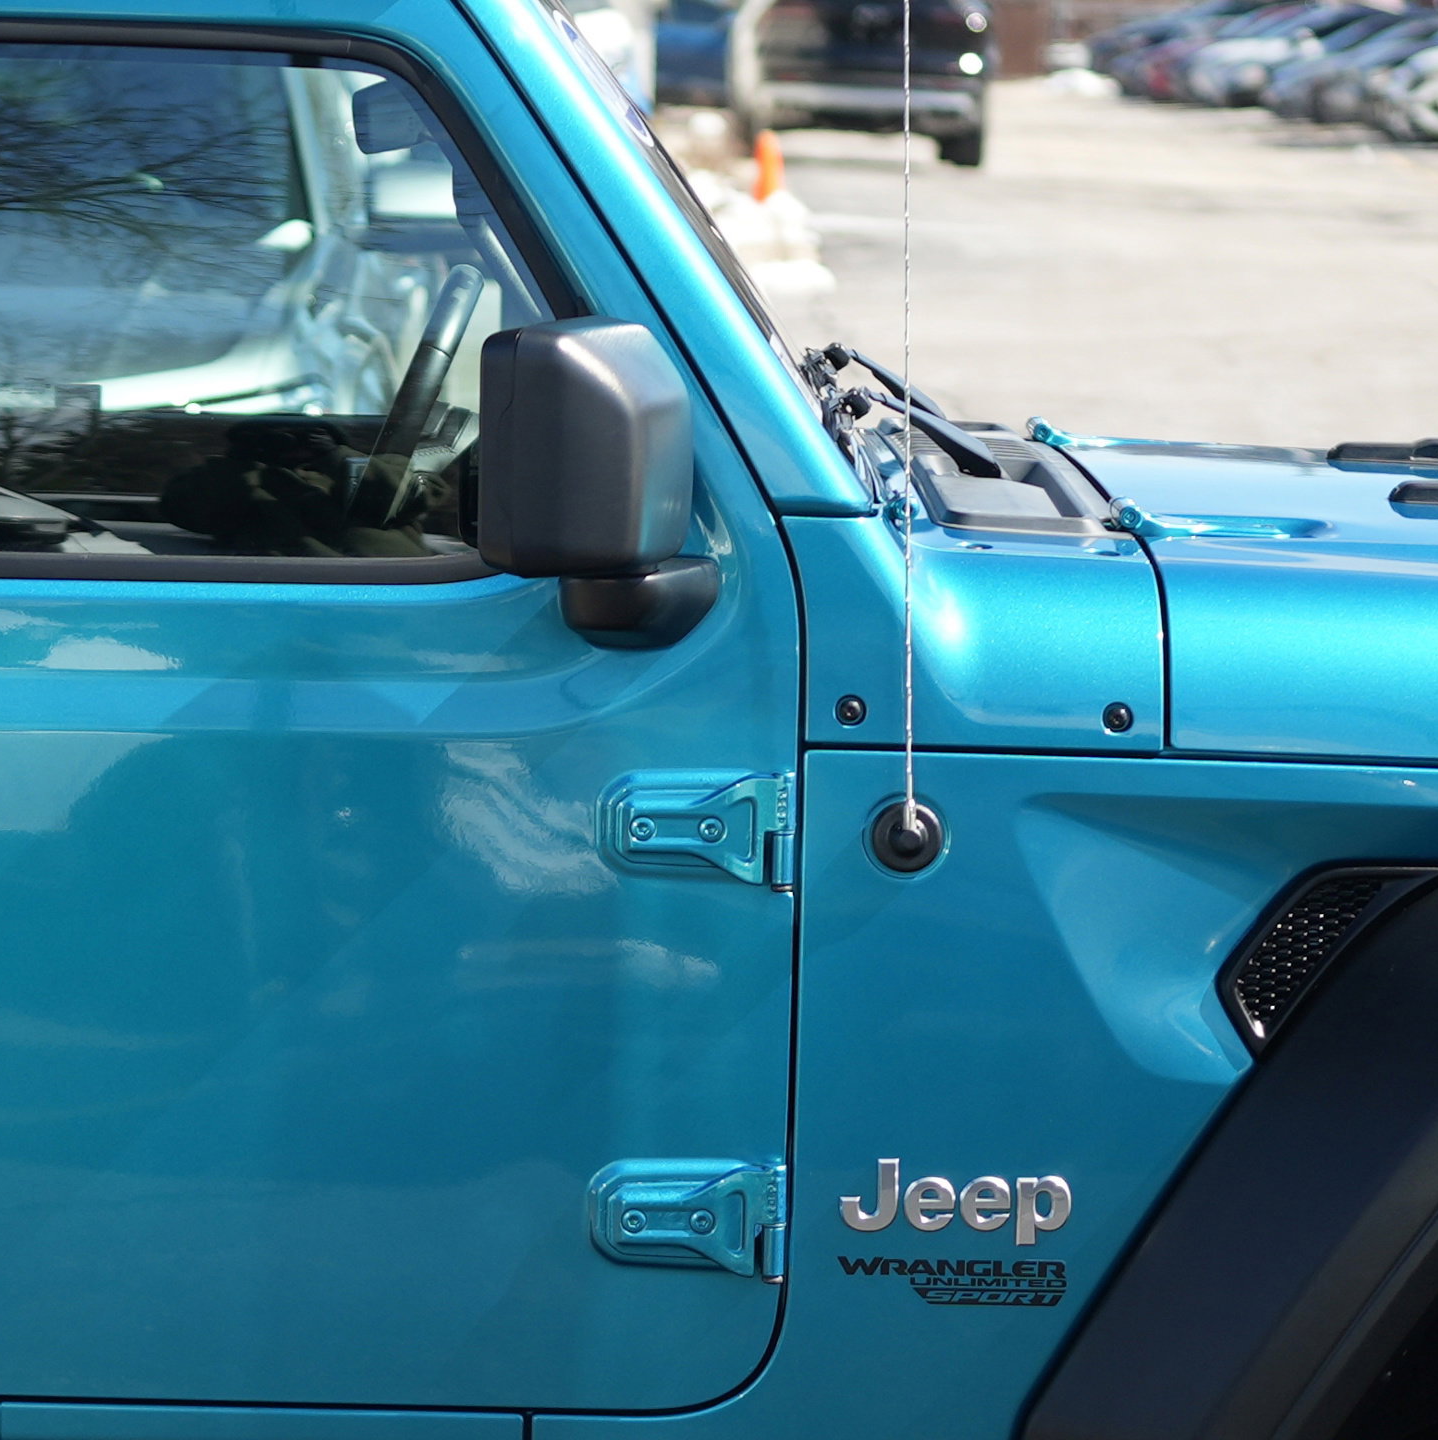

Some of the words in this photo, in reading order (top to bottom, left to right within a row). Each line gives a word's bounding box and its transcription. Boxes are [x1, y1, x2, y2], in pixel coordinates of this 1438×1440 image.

[839, 1157, 1072, 1247] Jeep
[837, 1255, 1067, 1279] WRANGLER
[909, 1277, 1068, 1289] UNLIMITED
[924, 1290, 1062, 1305] SPORT
